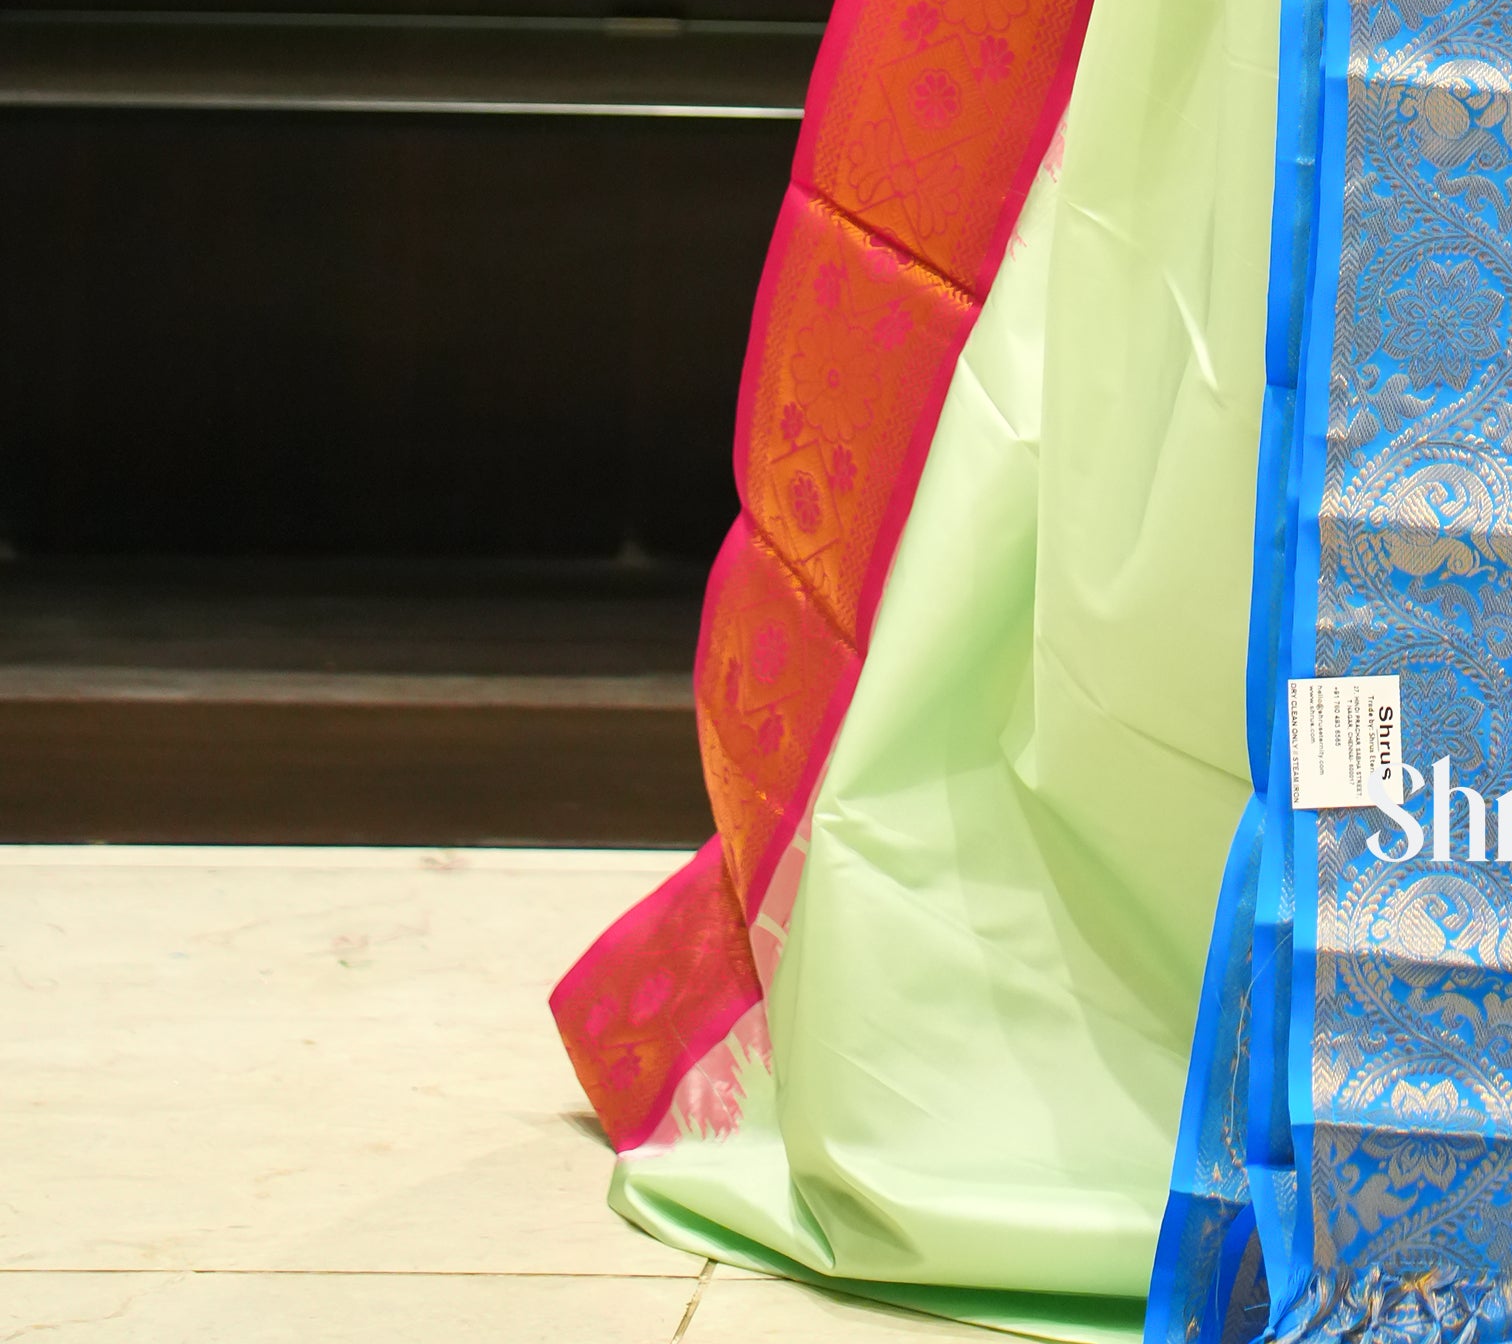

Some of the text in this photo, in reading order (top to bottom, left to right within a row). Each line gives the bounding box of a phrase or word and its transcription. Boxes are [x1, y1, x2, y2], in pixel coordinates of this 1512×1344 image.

[1290, 683, 1298, 699] DRY
[1290, 701, 1298, 727] CLEAN
[1353, 696, 1361, 714] HINDI
[1367, 696, 1375, 718] Trade
[1291, 728, 1299, 750] ONLY
[1354, 715, 1362, 746] PRACHAR
[1368, 733, 1376, 754] Shrus
[1379, 707, 1393, 780] Shrus
[1292, 757, 1300, 783] STEAM
[1292, 784, 1300, 804] IRON
